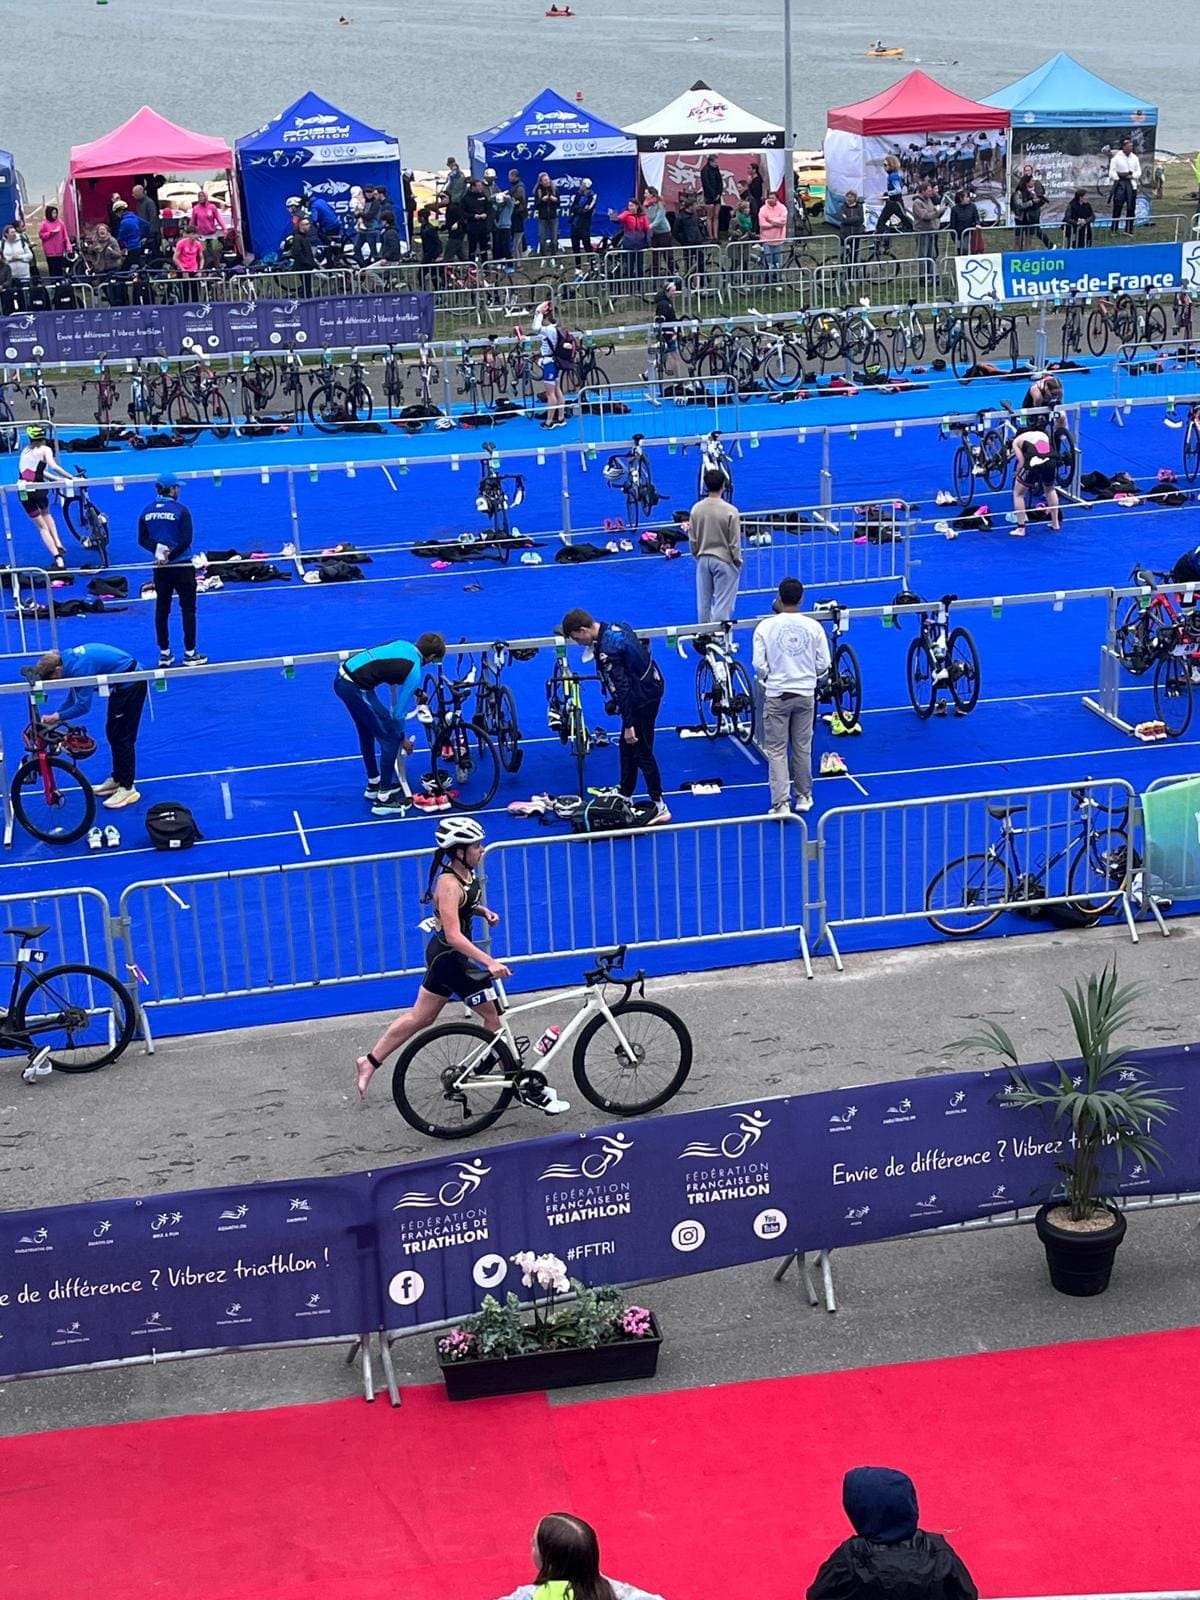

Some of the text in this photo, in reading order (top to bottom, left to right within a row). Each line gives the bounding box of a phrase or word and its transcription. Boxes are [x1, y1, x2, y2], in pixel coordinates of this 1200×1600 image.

[283, 125, 350, 138] POISSY
[524, 122, 590, 131] POISSY
[524, 128, 590, 136] TRIATHLON
[284, 133, 349, 142] TRIATHLON
[1010, 257, 1065, 275] Région
[1012, 271, 1173, 297] Hauts-de-France
[145, 512, 175, 521] OFFICIEL
[471, 994, 481, 1006] 57
[833, 1163, 879, 1185] Envie
[885, 1156, 905, 1177] de
[911, 1149, 992, 1174] différence
[997, 1140, 1007, 1162] ?
[1013, 1136, 1063, 1158] Vibrez
[685, 1162, 769, 1182] FÉDÉRATION
[686, 1173, 769, 1192] FRANÇAISE DE
[545, 1182, 630, 1203] FÉDÉRATION
[546, 1192, 630, 1213] FRANÇAISE DE
[687, 1183, 769, 1205] TRIATHLON
[401, 1208, 487, 1231] FÉDÉRATION
[547, 1202, 631, 1226] TRIATHLON
[401, 1218, 487, 1241] FRANÇAISE DE
[403, 1228, 488, 1255] TRIATHLON
[567, 1240, 615, 1261] #FFTRI
[17, 1283, 41, 1304] de
[49, 1277, 143, 1300] différence
[149, 1270, 161, 1291] ?
[168, 1265, 228, 1287] Vibrez
[233, 1252, 317, 1279] triathlon
[324, 1247, 330, 1267] !
